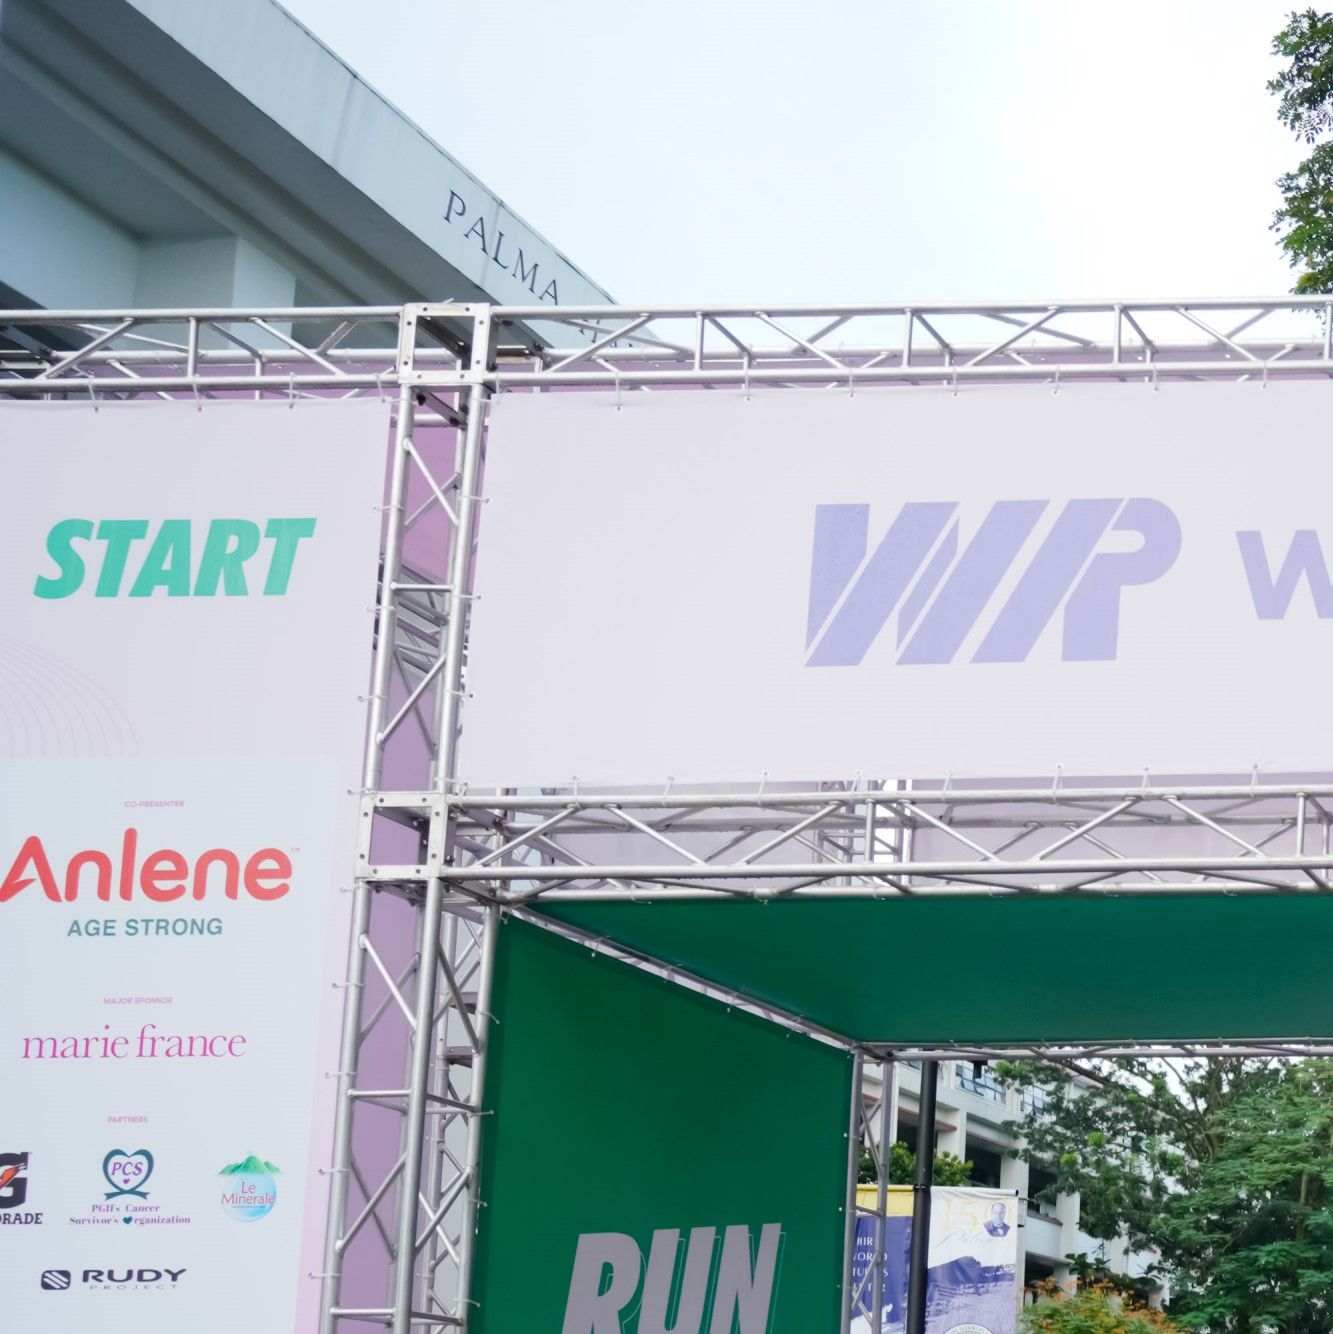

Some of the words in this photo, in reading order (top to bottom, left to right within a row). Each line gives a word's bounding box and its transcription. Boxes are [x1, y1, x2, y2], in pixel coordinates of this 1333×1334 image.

[443, 190, 558, 305] PALMA
[33, 517, 317, 600] START
[0, 828, 293, 902] Anlene
[67, 919, 116, 938] AGE
[125, 918, 223, 937] STRONG
[22, 1024, 129, 1059] marie
[136, 1024, 248, 1058] france
[111, 1161, 143, 1176] PCS
[241, 1181, 256, 1194] Le
[221, 1193, 276, 1205] Minerale
[82, 1268, 187, 1283] RUDY
